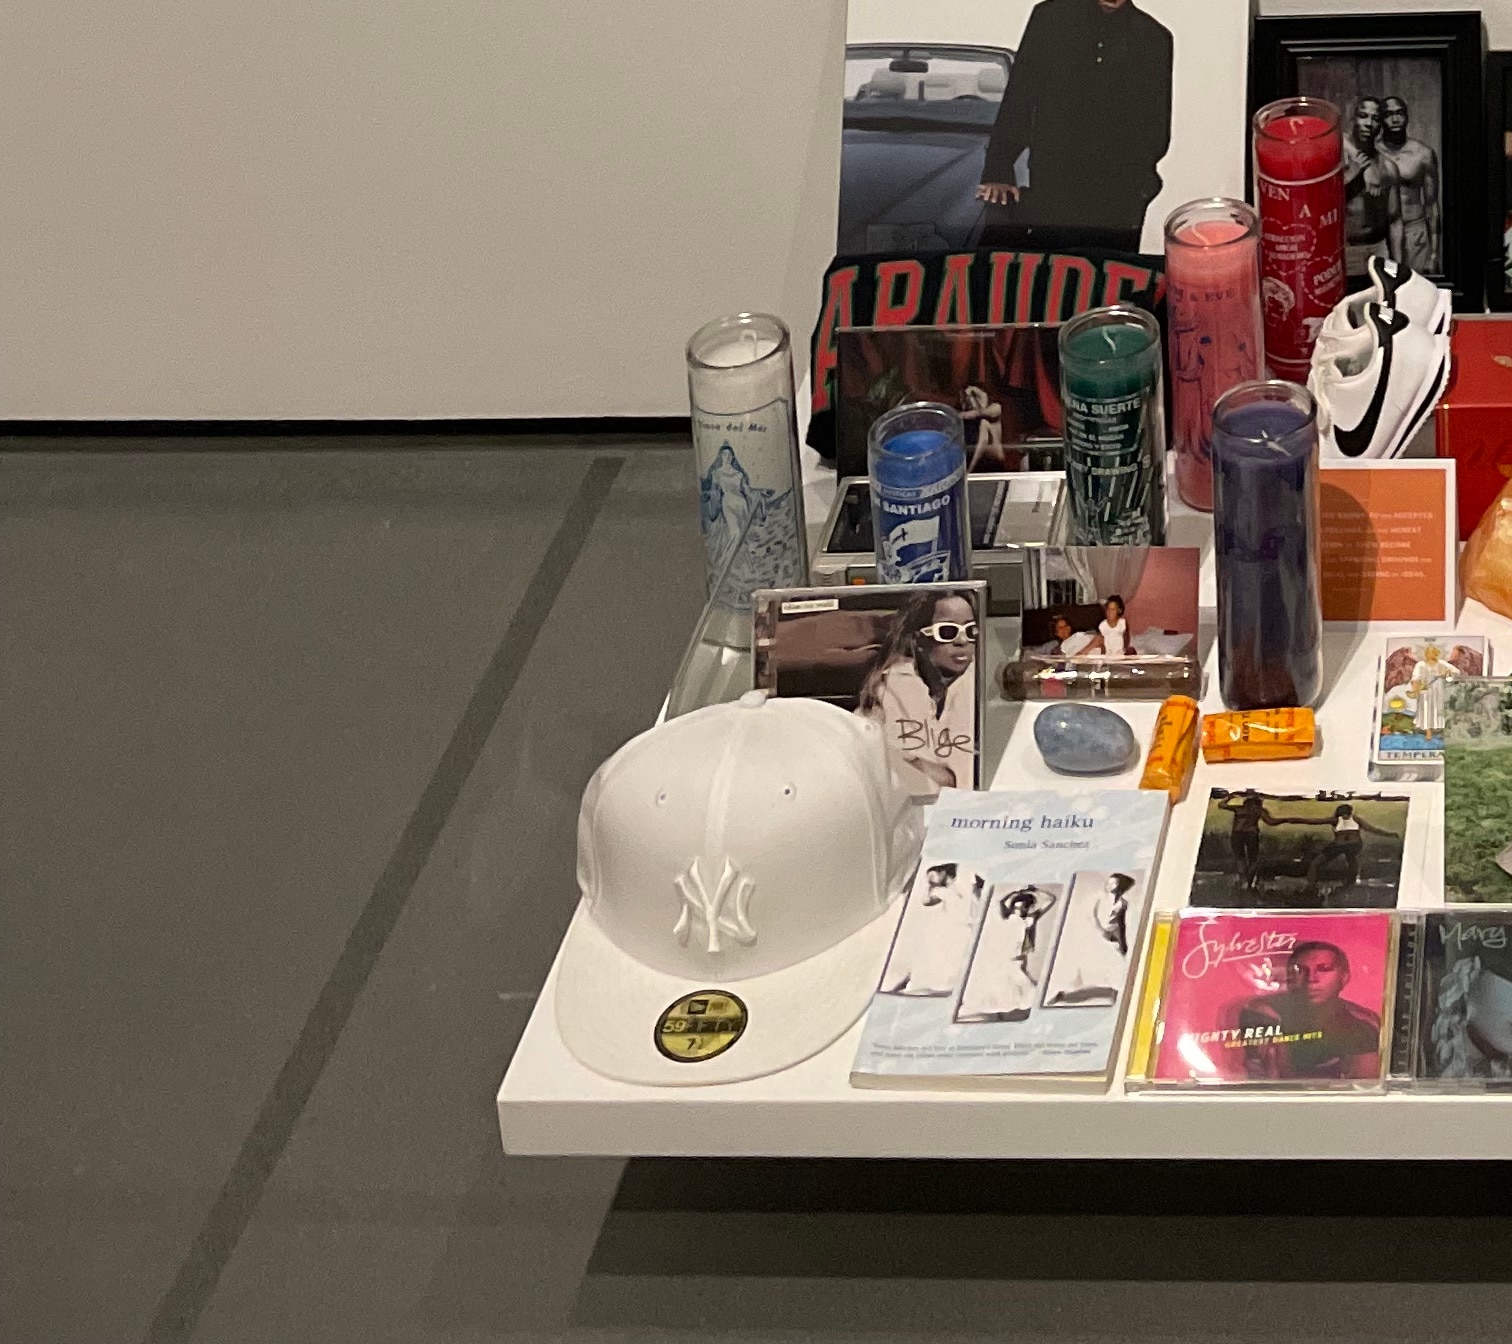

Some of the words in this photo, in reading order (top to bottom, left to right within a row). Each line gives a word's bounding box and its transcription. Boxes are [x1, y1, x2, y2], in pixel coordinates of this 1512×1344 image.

[1260, 180, 1290, 201] VEN
[1299, 204, 1311, 219] A
[1091, 398, 1141, 415] SUERTE
[882, 493, 951, 516] SANTIAGO
[895, 717, 974, 759] Blige
[950, 815, 1034, 833] morning
[1040, 814, 1094, 829] haiku
[1439, 921, 1508, 951] Mary
[1182, 919, 1299, 979] Sylvester
[1244, 1024, 1284, 1039] REAL
